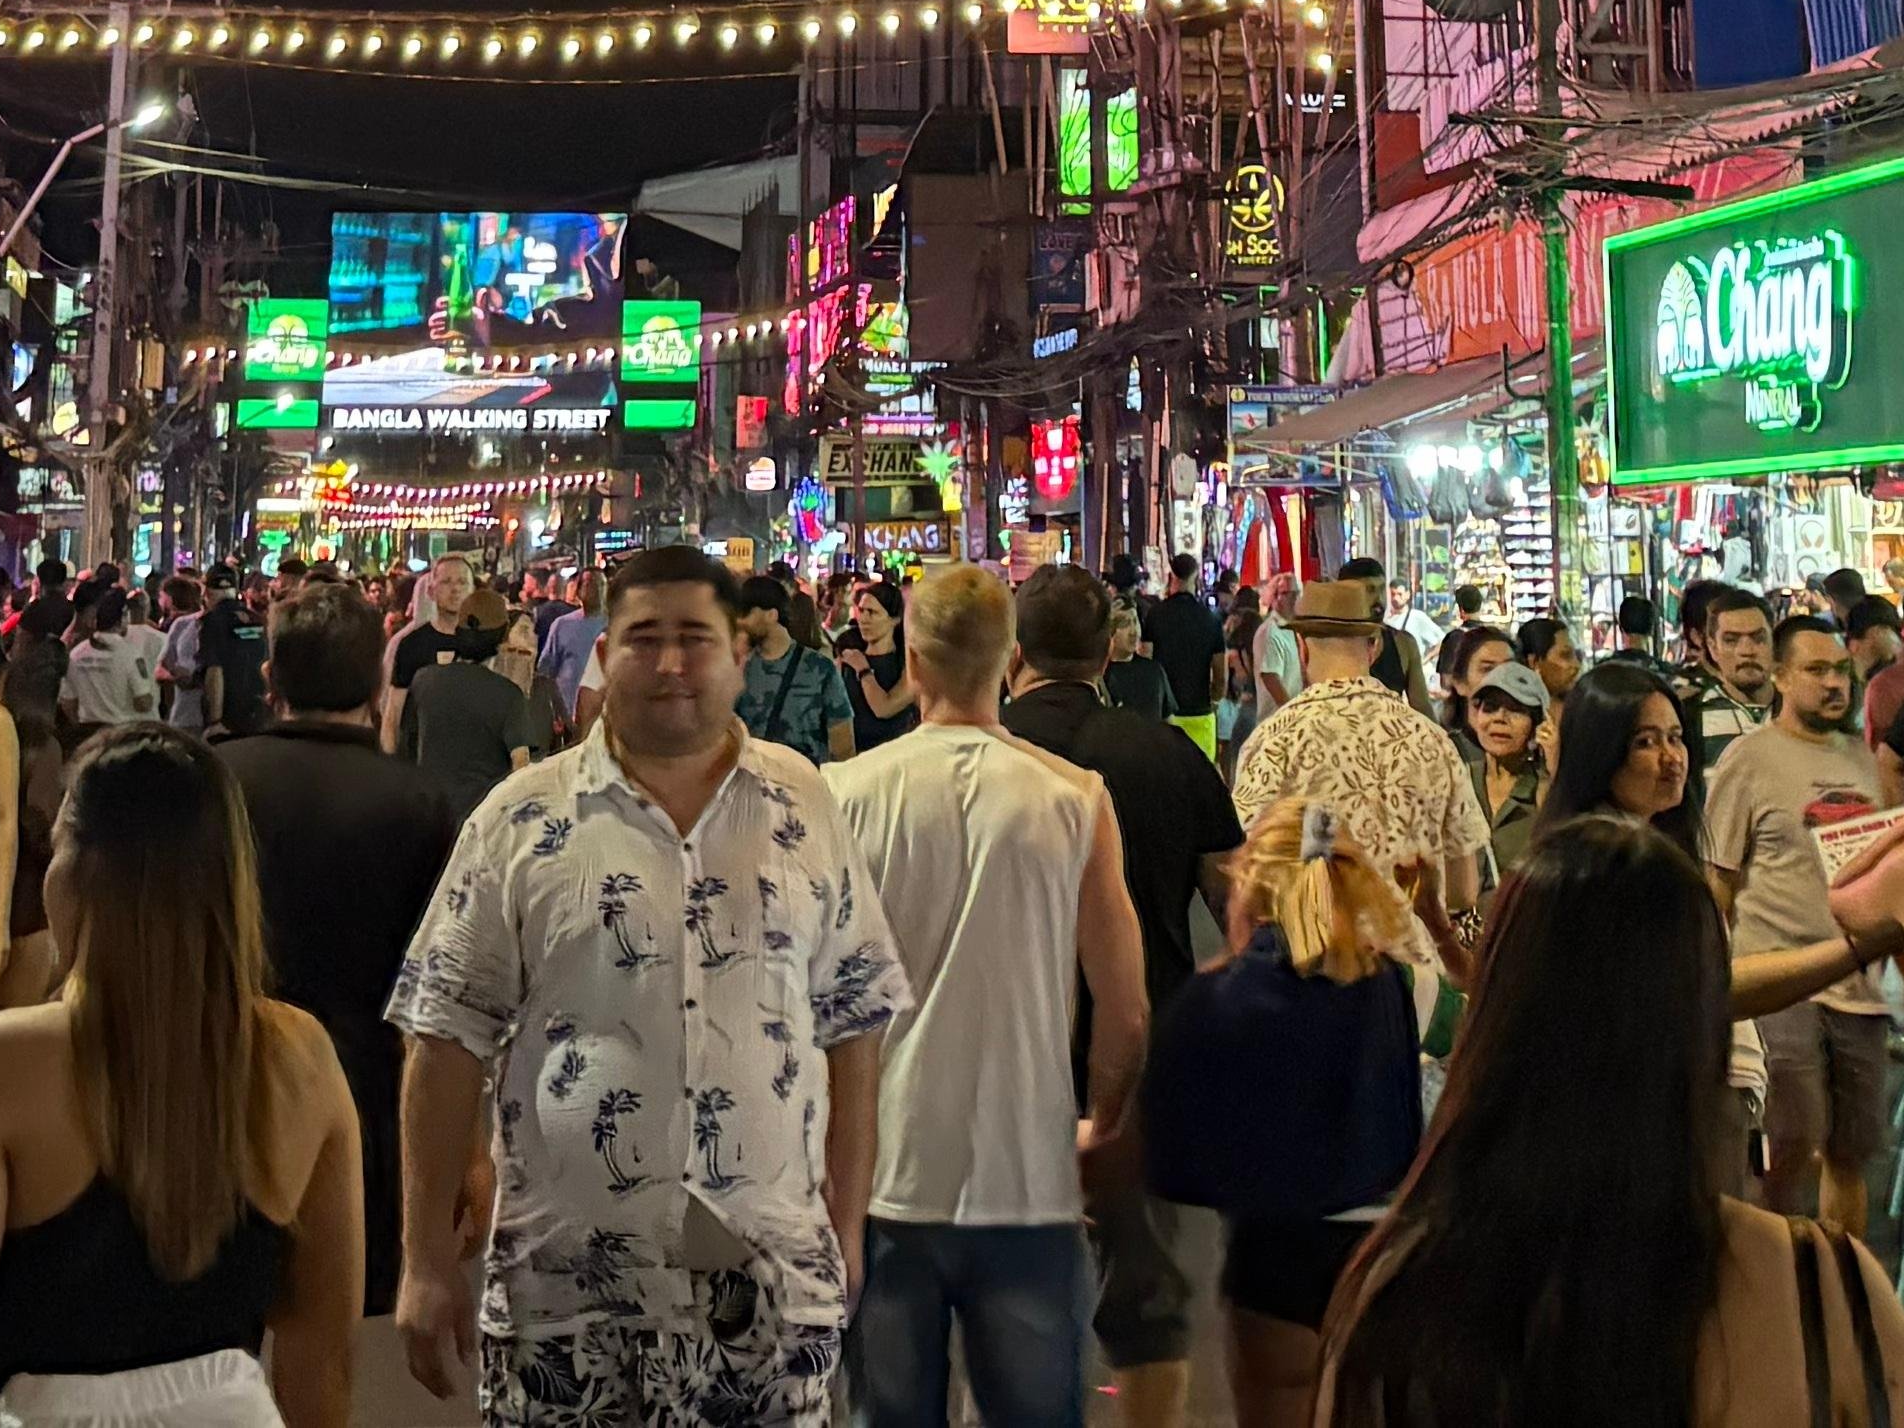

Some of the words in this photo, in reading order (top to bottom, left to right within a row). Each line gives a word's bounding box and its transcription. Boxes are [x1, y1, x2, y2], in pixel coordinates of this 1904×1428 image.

[1707, 247, 1832, 383] Chang
[333, 408, 423, 430] BANGLA
[427, 408, 527, 429] WALKING
[533, 409, 611, 430] STREET
